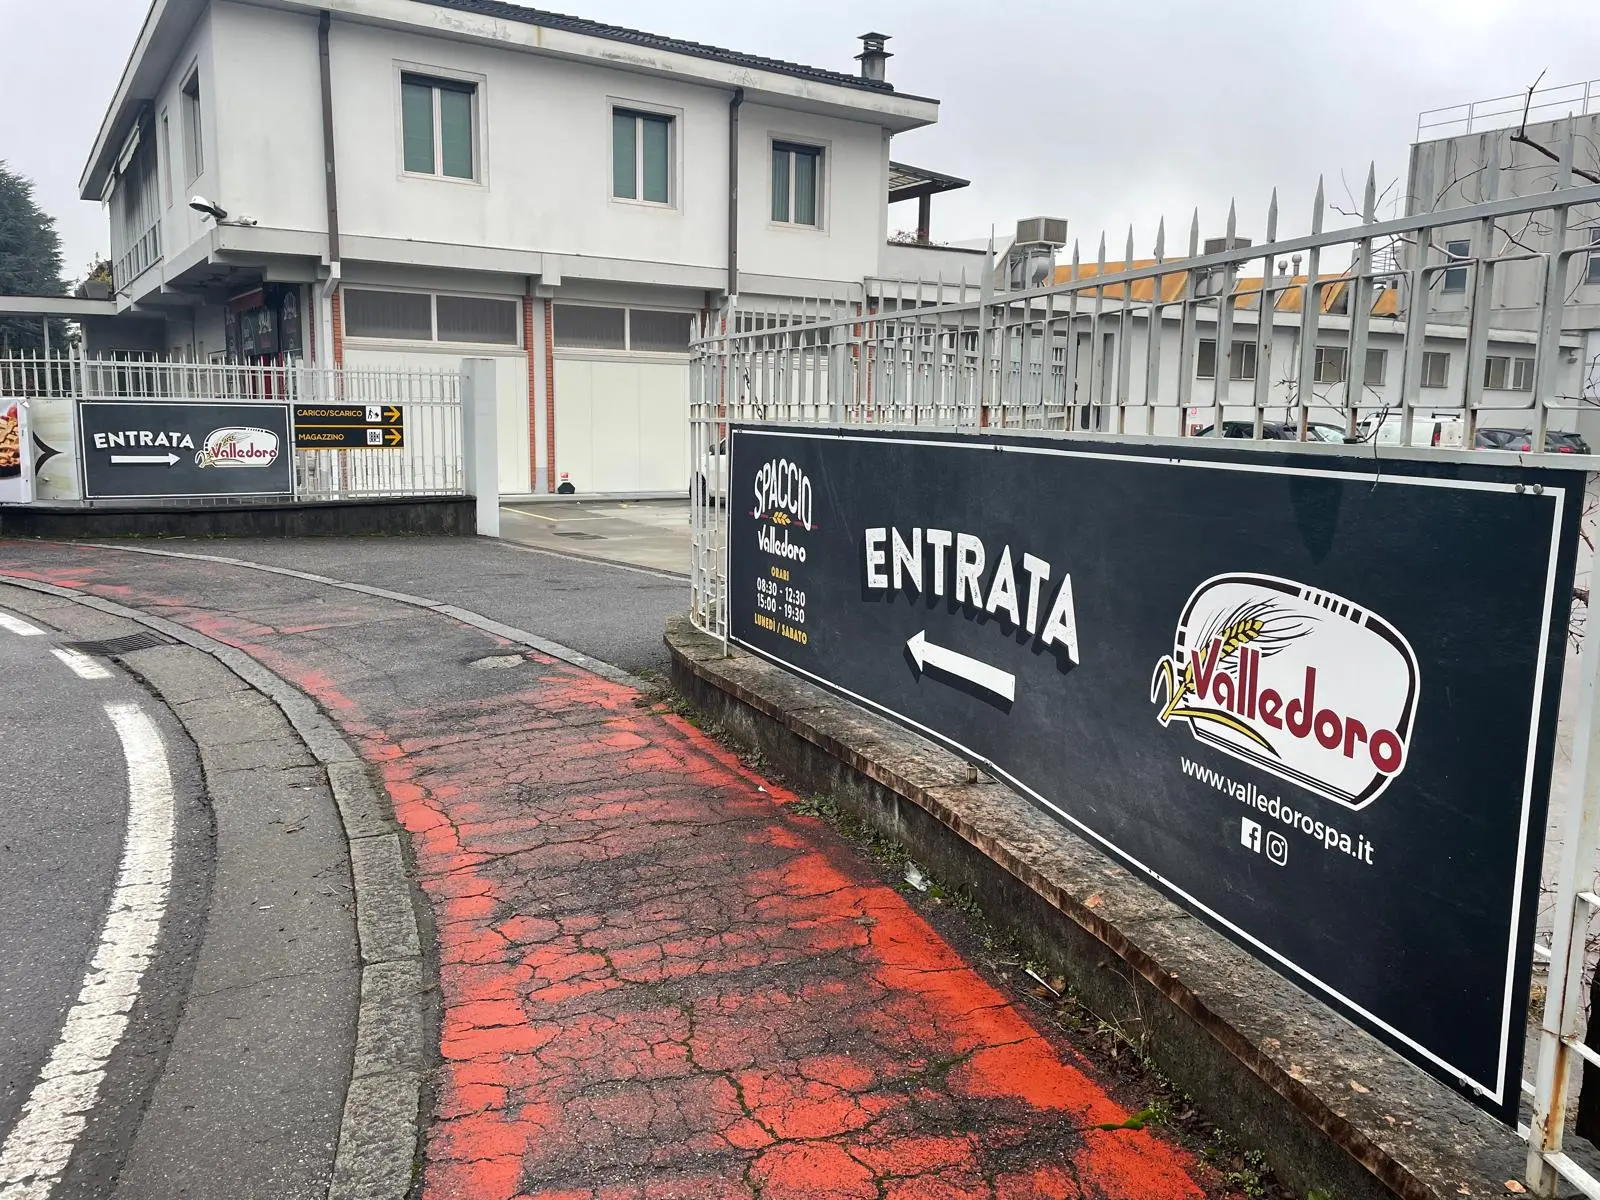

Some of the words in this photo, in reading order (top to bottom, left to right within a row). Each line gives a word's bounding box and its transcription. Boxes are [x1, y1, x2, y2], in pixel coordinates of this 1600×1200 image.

[296, 409, 363, 417] CARICO/SCARICO
[93, 430, 195, 449] ENTRATA
[211, 442, 277, 459] Valledoro
[298, 433, 345, 441] MAGAZZINO
[753, 458, 812, 531] SPACCIO
[757, 524, 806, 563] Valledoro
[771, 566, 790, 582] ORARI
[756, 576, 778, 597] 08:30
[784, 586, 806, 607] 12:30
[865, 526, 1080, 665] ENTRATA
[757, 592, 777, 613] 15:00
[783, 603, 805, 624] 19:30
[781, 624, 808, 645] SABATO
[1190, 637, 1403, 774] Valledoro
[1180, 755, 1375, 866] www.valledorospa.it
